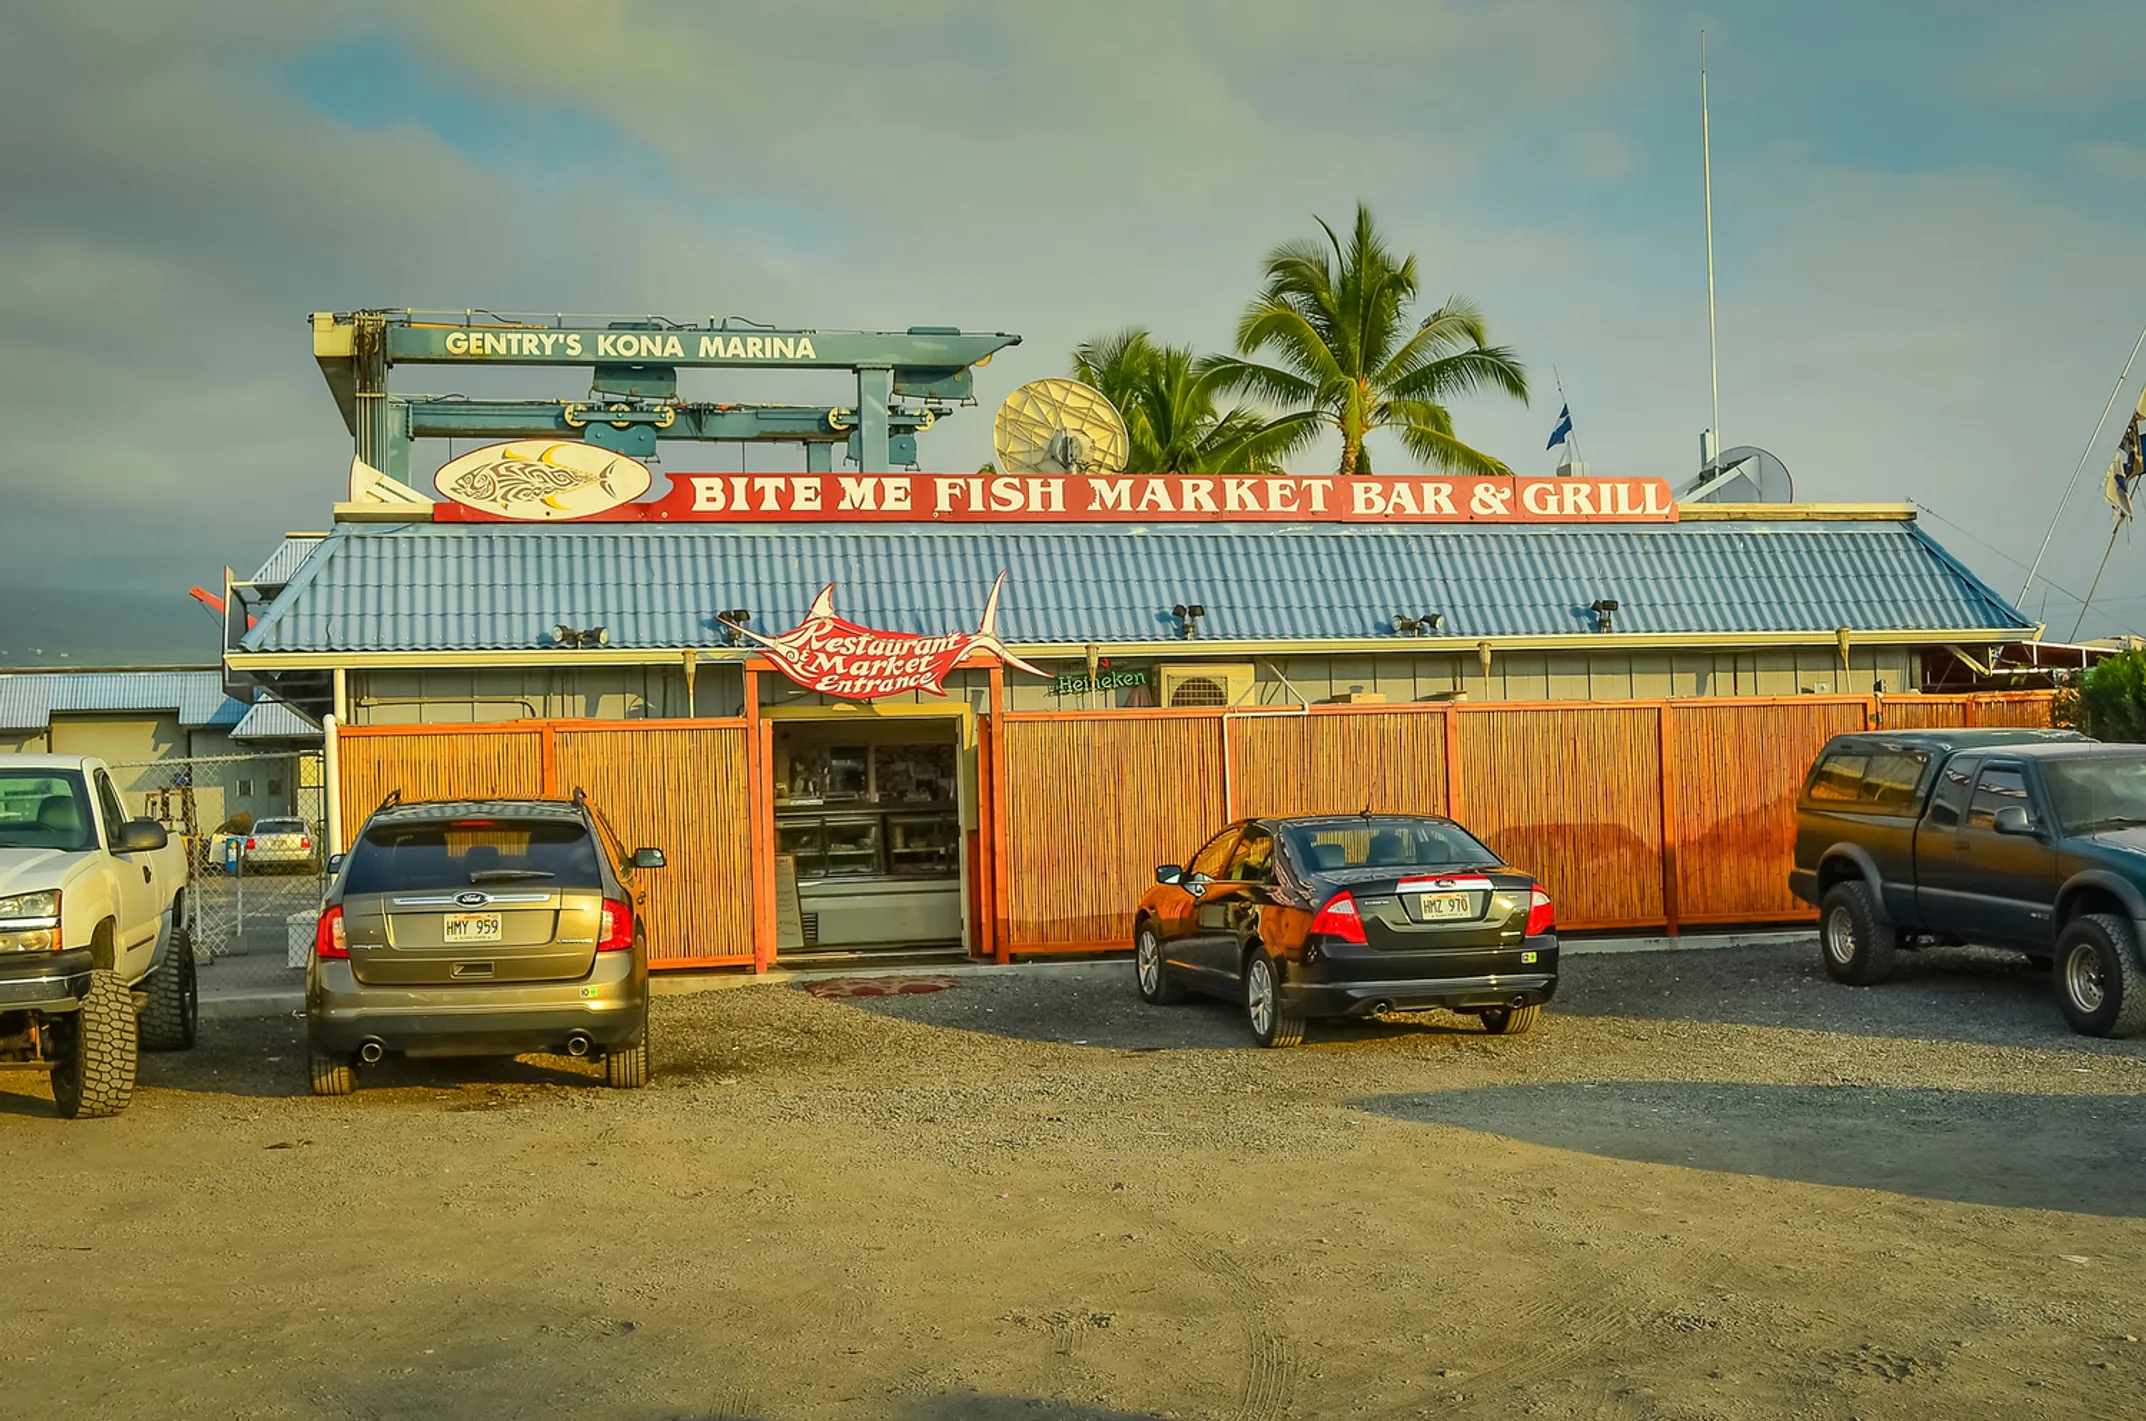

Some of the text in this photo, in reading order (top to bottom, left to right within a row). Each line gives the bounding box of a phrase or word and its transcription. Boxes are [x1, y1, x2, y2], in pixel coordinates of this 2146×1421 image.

[445, 331, 817, 359] GENTRY'S KONA MARINA
[689, 477, 1672, 517] BITE ME FISH MARKET BAR & GRILL
[792, 618, 965, 657] Restaurant
[806, 652, 943, 676] Market
[815, 671, 939, 694] Entrance
[1448, 898, 1468, 913] 970
[446, 919, 499, 936] HMY 959
